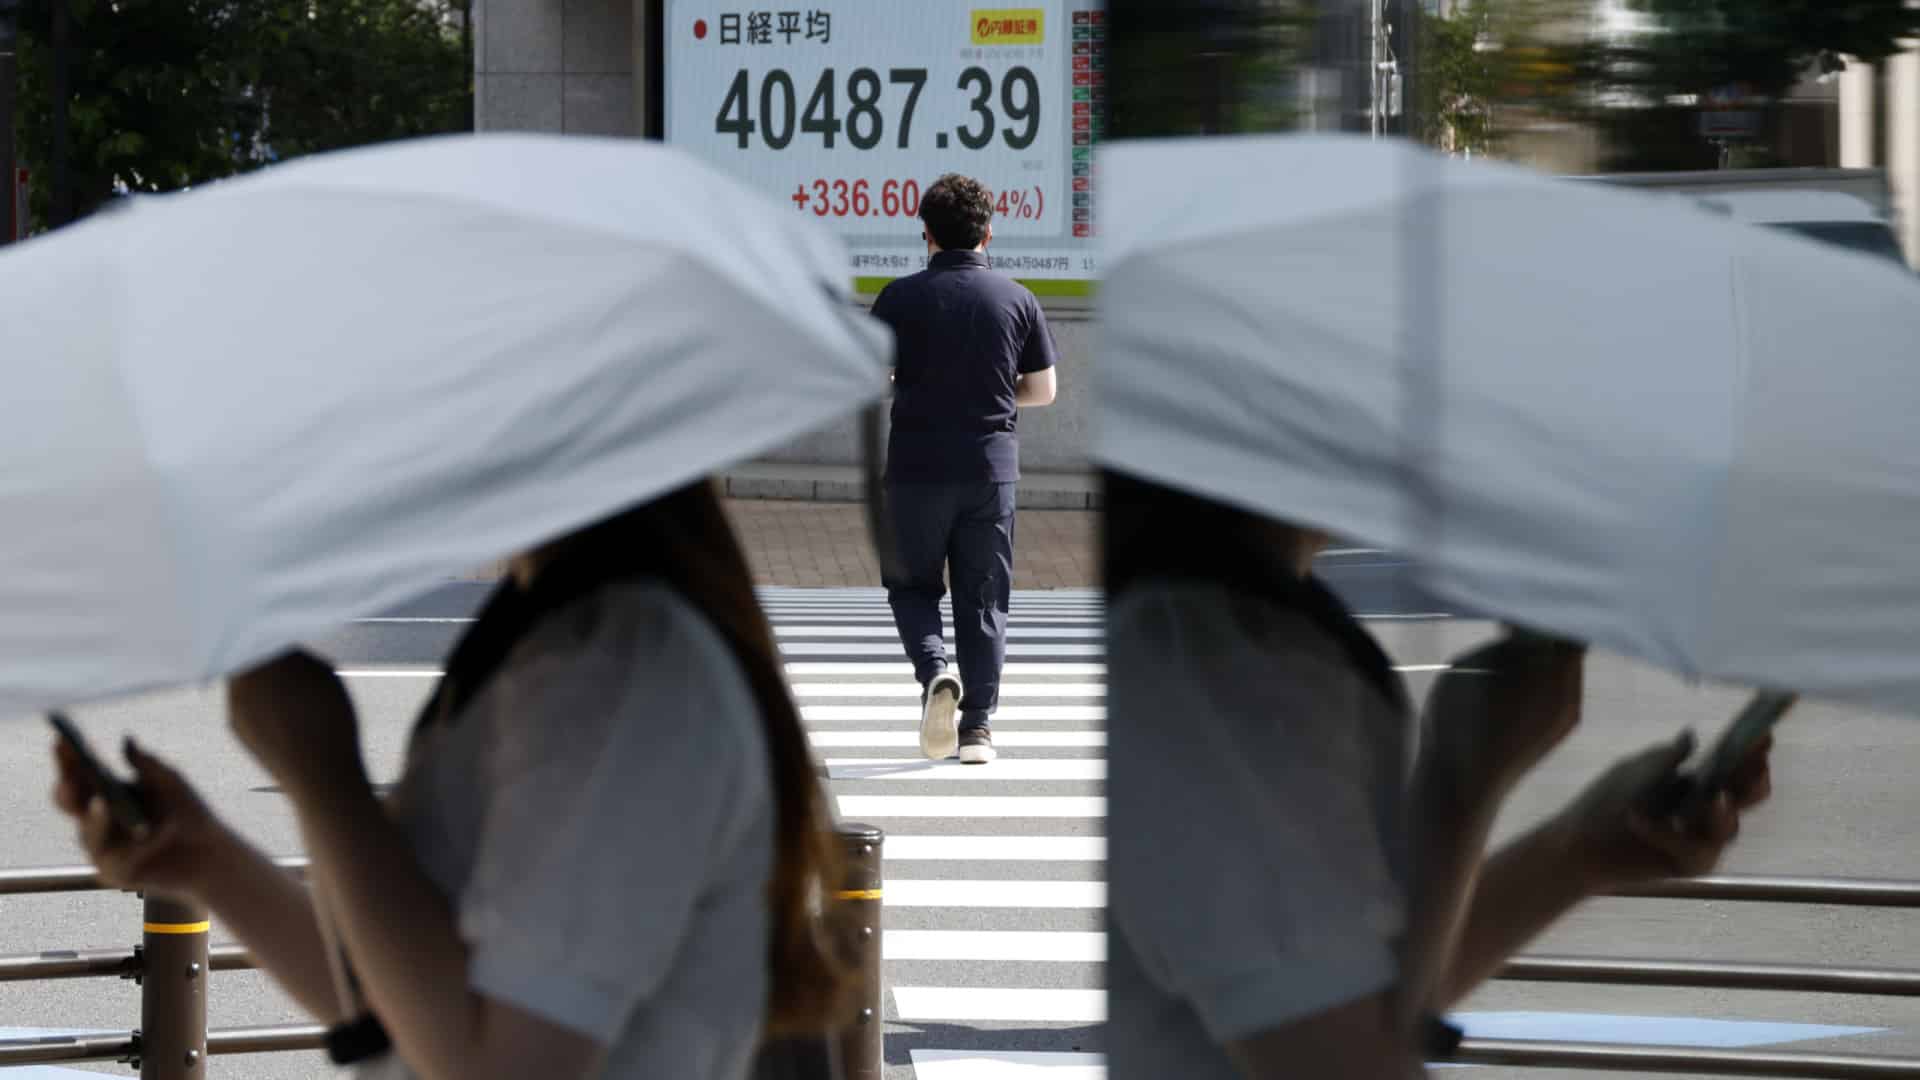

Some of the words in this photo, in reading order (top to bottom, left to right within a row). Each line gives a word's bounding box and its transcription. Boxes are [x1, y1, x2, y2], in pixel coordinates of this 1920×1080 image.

[719, 11, 832, 45] 日経平均
[715, 67, 1041, 150] 40487.39
[792, 179, 919, 217] +336.60
[990, 187, 1045, 219] 4%)
